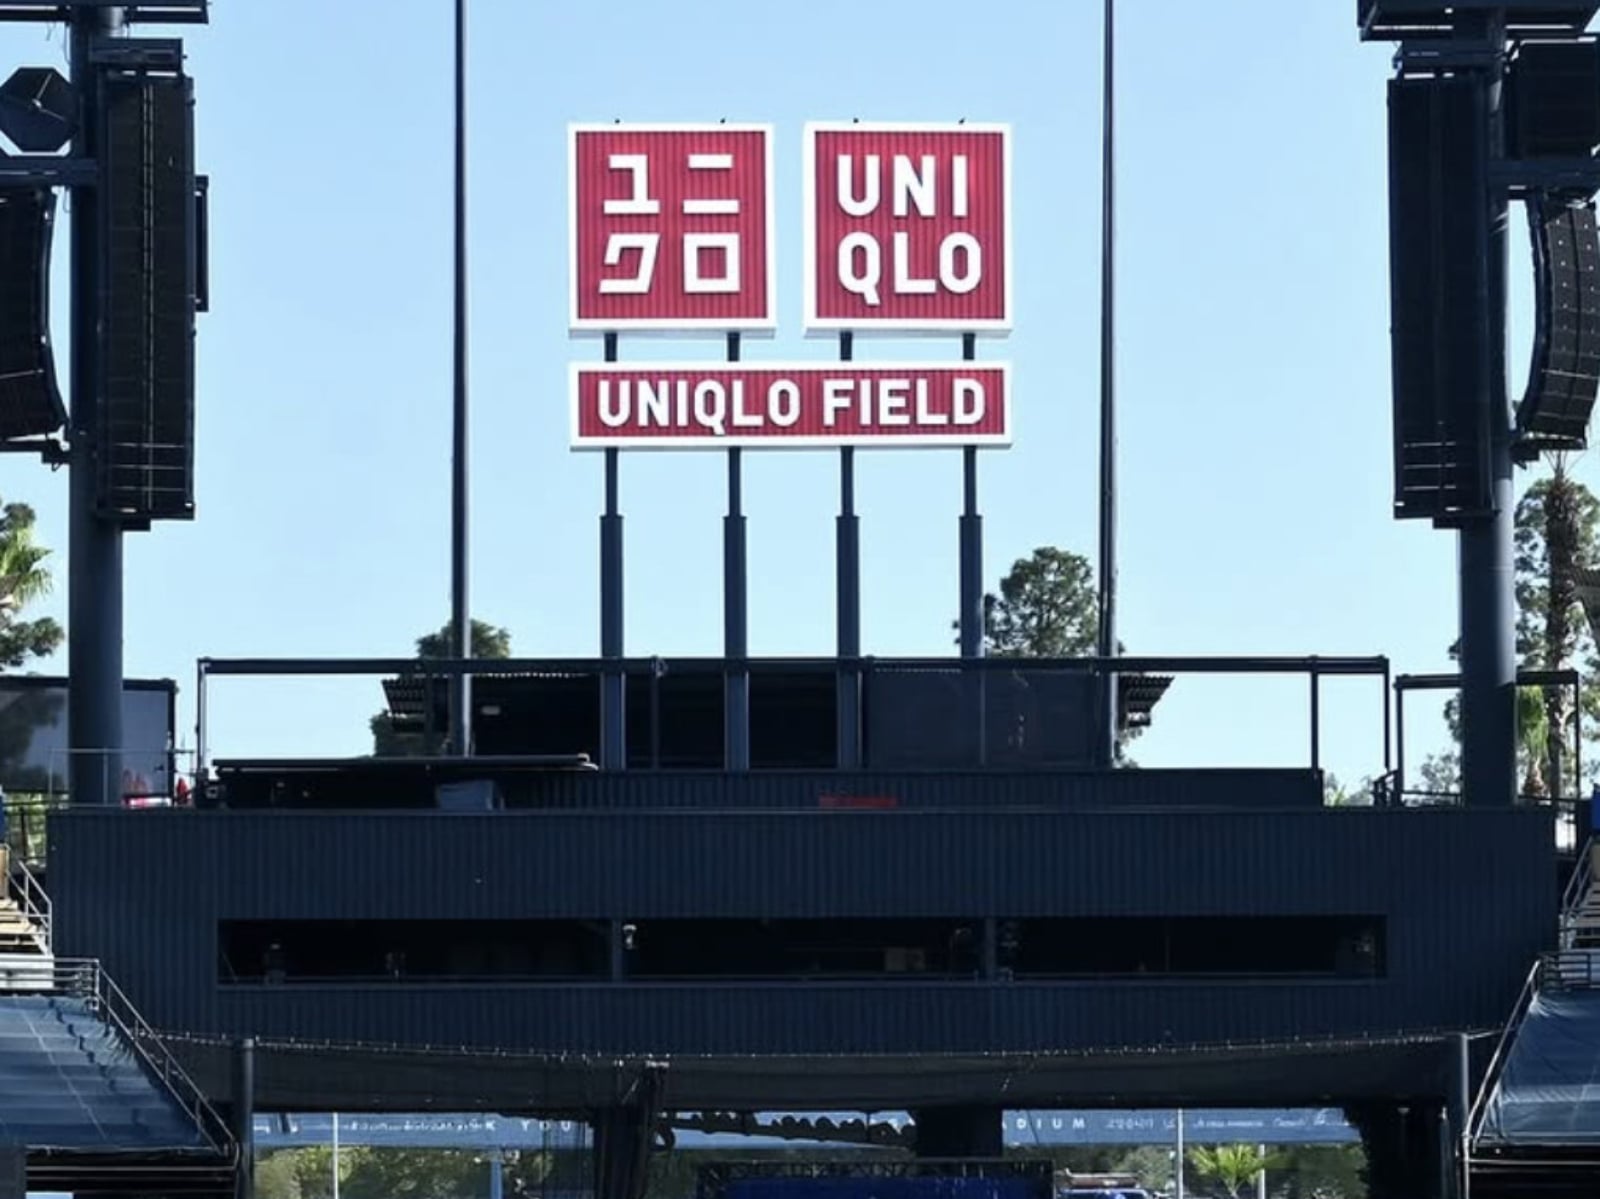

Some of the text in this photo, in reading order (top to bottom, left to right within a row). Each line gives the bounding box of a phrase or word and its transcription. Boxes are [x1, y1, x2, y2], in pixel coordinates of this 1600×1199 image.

[604, 154, 740, 214] ユニ
[837, 154, 967, 217] UNI
[600, 232, 740, 293] クロ
[837, 231, 981, 305] QLO
[598, 378, 985, 434] UNIQLO FIELD
[1002, 1118, 1086, 1130] DIUM
